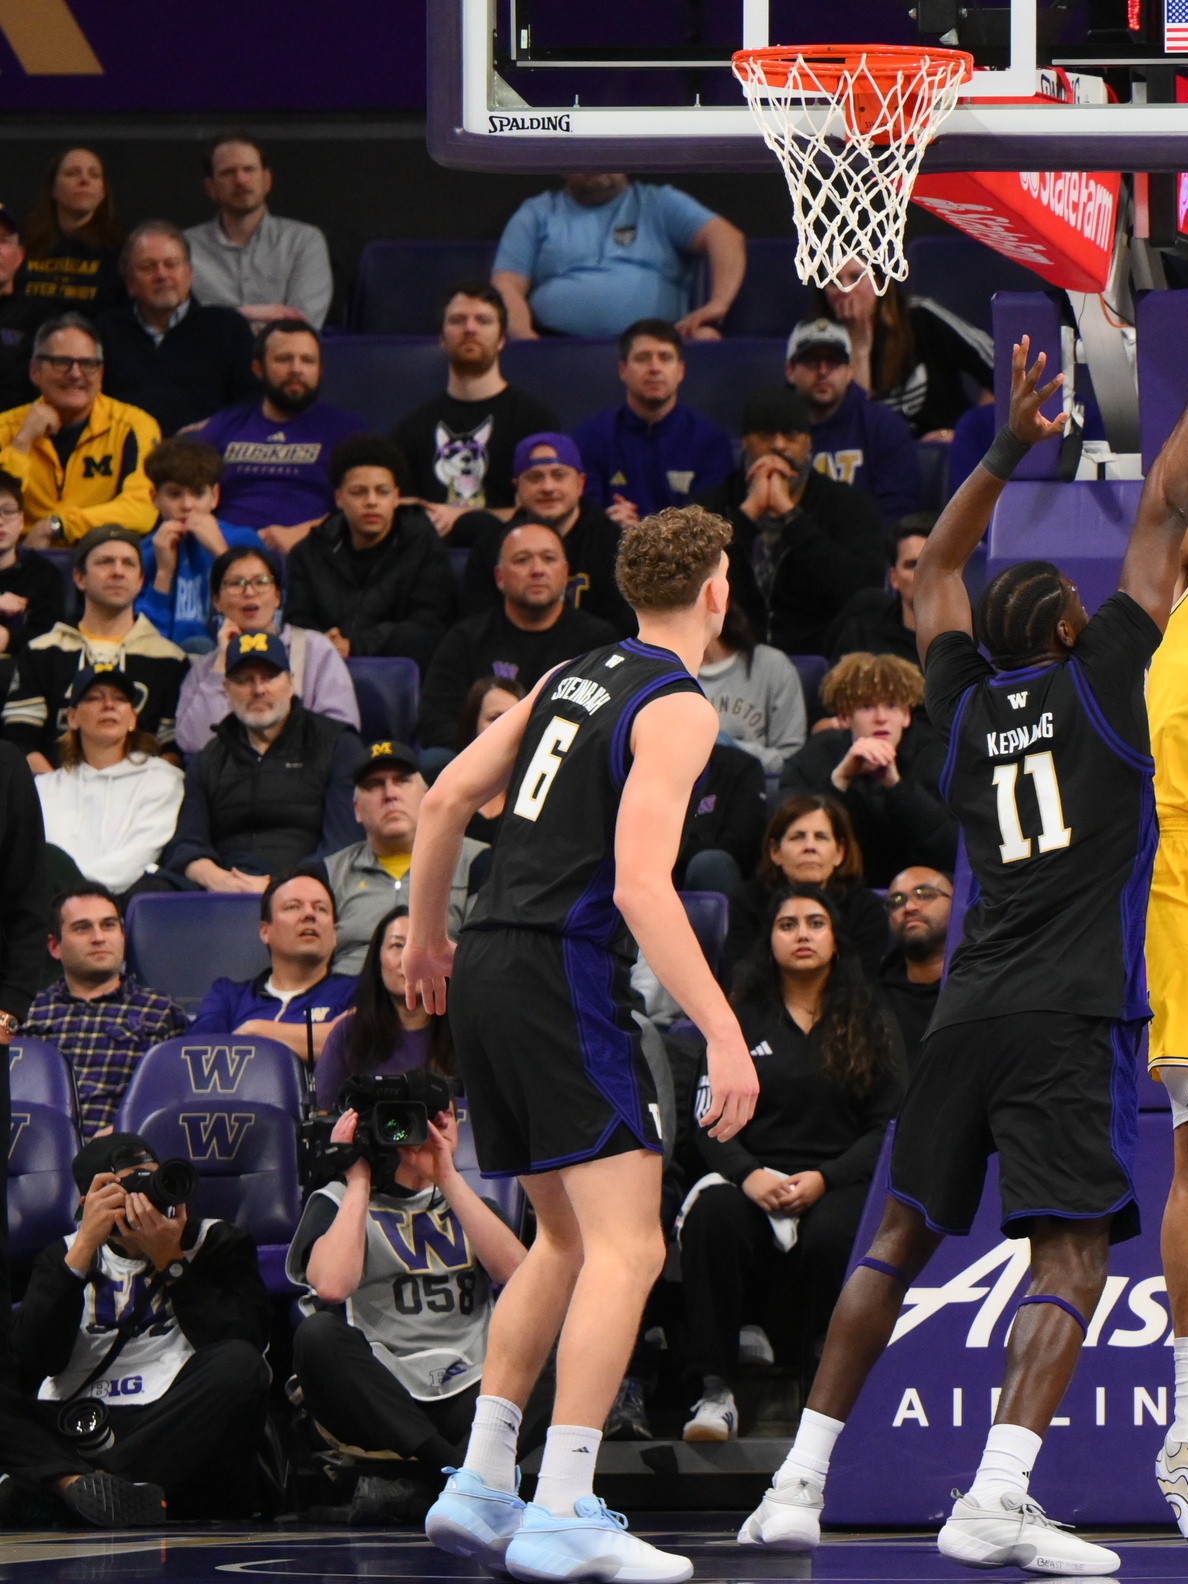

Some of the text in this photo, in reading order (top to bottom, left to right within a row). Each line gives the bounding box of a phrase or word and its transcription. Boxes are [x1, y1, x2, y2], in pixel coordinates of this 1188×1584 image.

[488, 114, 570, 133] SPALDING
[83, 454, 113, 478] M
[225, 441, 321, 465] HUSKIES
[239, 633, 268, 654] M
[1007, 691, 1028, 710] W
[371, 741, 392, 759] M
[513, 715, 580, 822] 6
[992, 750, 1072, 864] 11
[181, 1046, 255, 1094] W
[179, 1113, 255, 1161] W
[368, 1207, 474, 1275] W
[392, 1273, 477, 1316] 058
